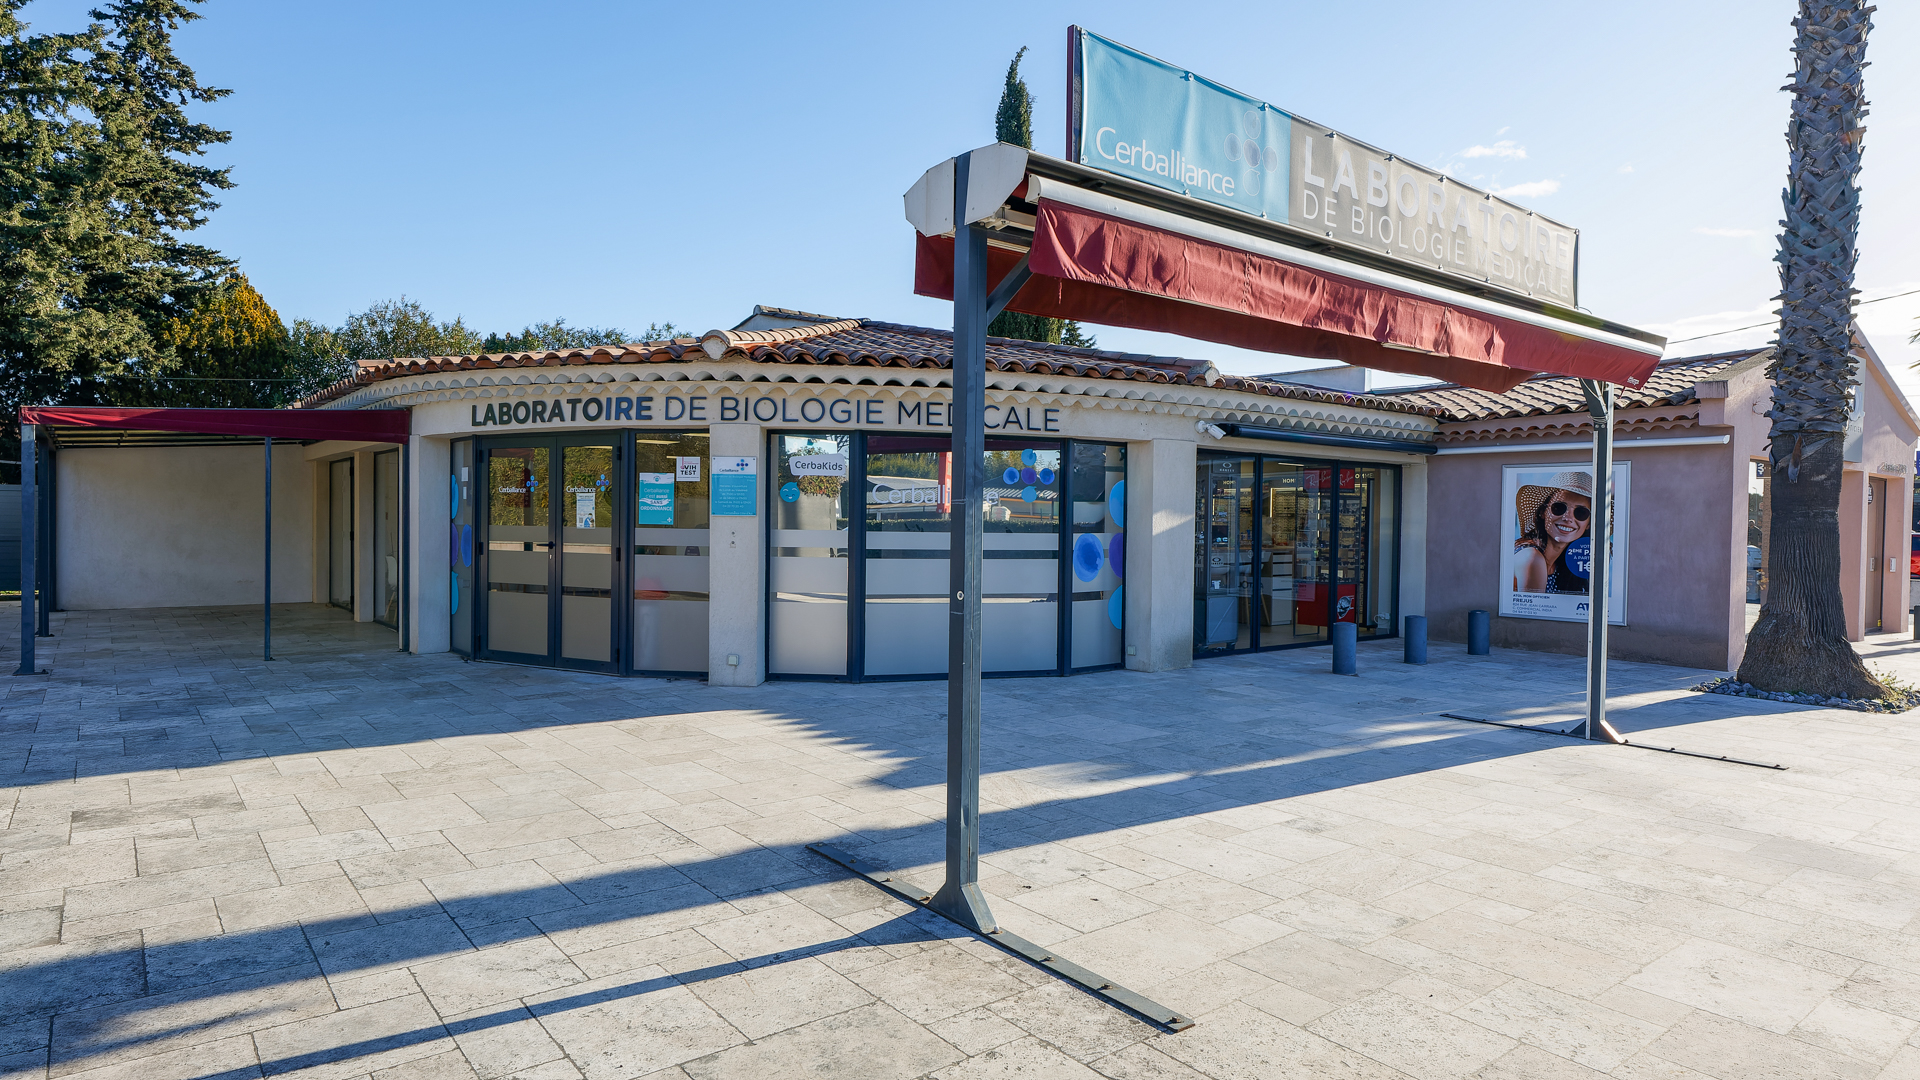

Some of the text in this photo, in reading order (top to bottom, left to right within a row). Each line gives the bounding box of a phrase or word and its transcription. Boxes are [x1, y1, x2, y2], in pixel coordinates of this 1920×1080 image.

[1096, 127, 1235, 197] Cerballiance
[1304, 135, 1569, 271] LABORATOIRE
[1303, 190, 1569, 298] DE BIOLOGIE MEDICALE
[471, 396, 1061, 432] LABORATOIRE DE BIOLOGIE MECALE
[795, 461, 843, 471] CerbaKids
[872, 483, 999, 505] Cerballie
